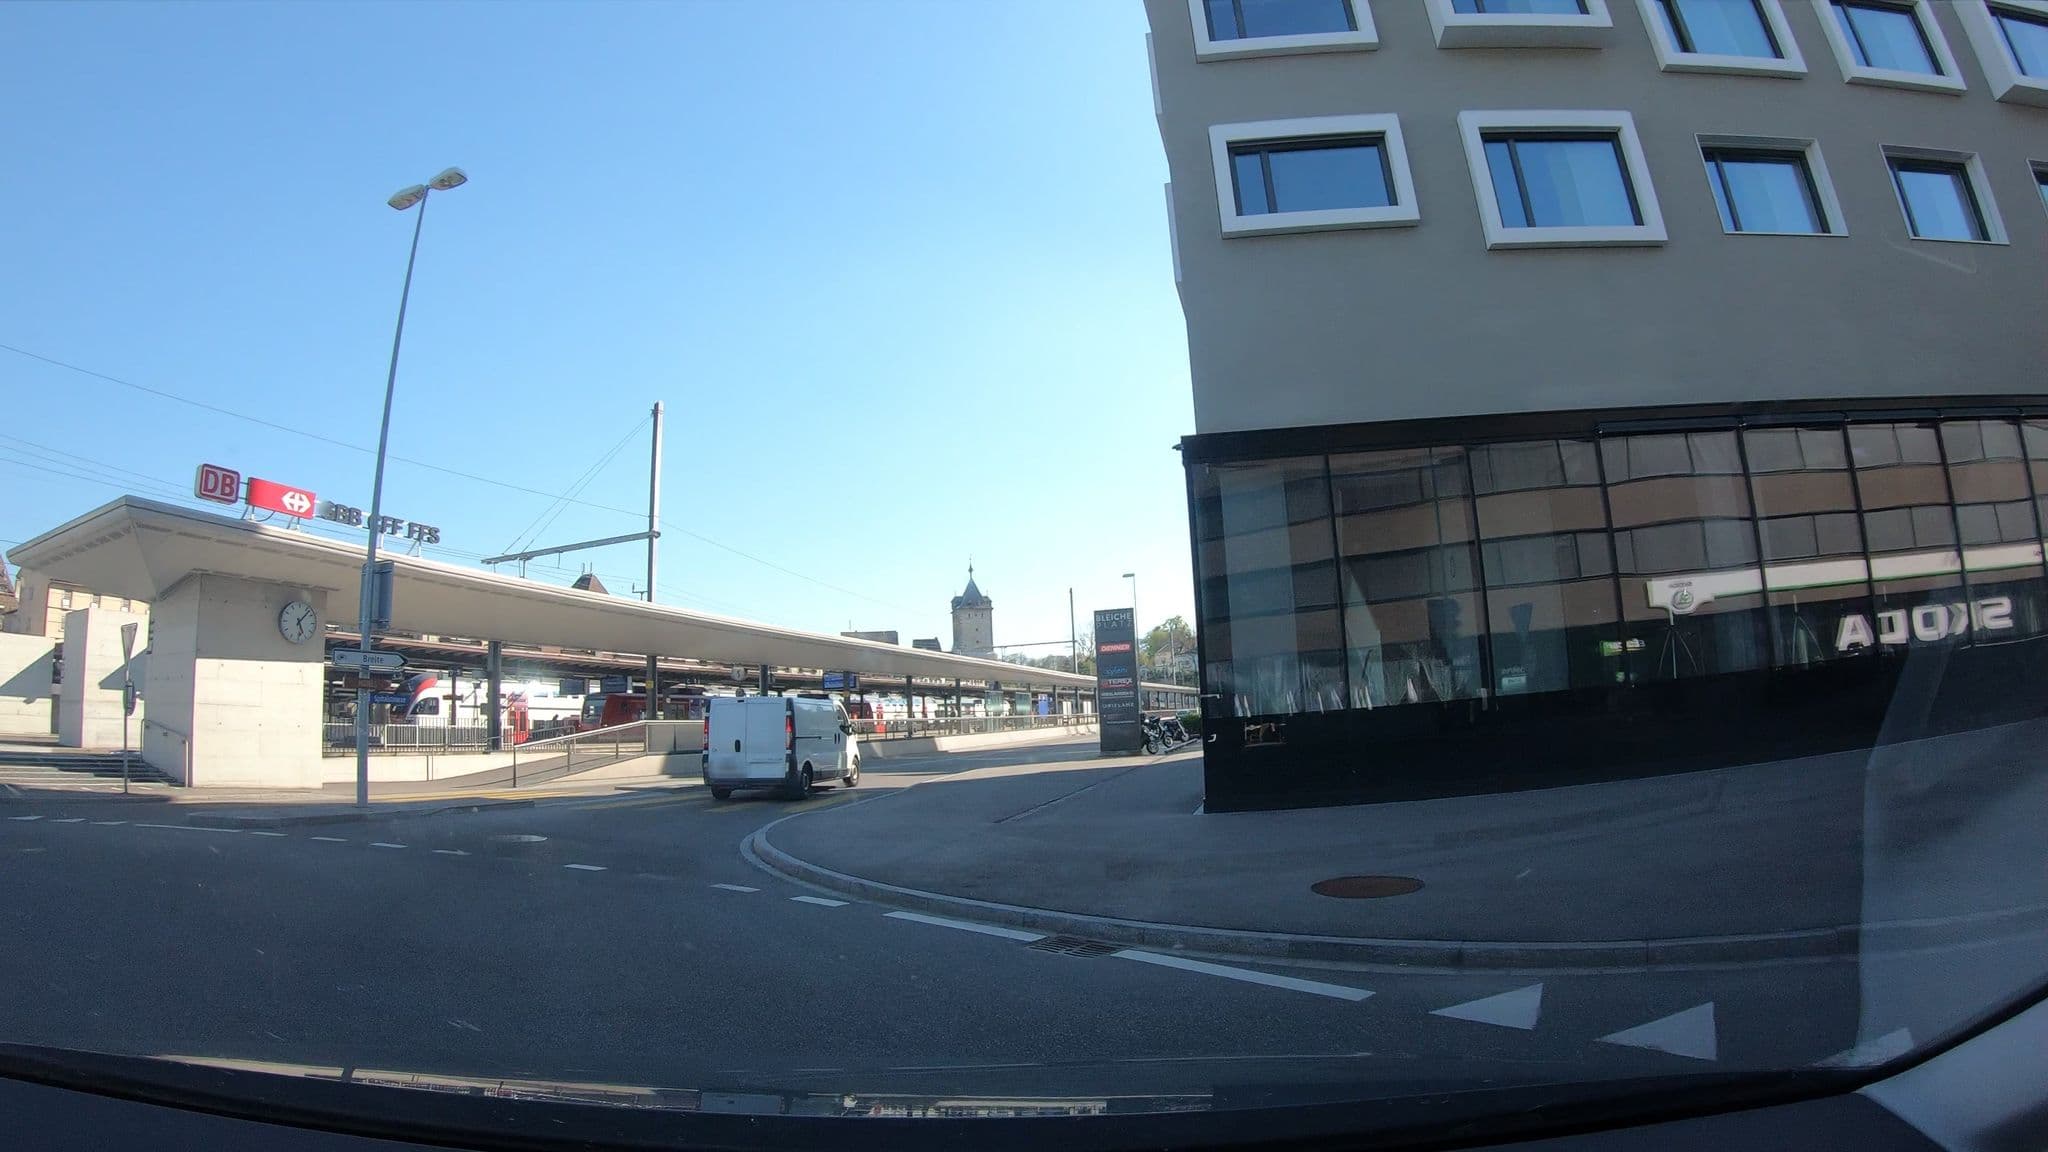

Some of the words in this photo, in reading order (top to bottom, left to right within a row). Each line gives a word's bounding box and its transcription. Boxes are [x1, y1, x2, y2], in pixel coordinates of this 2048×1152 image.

[202, 469, 236, 497] DB
[406, 521, 441, 544] FFS
[1095, 612, 1133, 622] BLEICHE
[1095, 620, 1133, 630] PLATZ
[1100, 644, 1130, 652] DENNER
[362, 654, 385, 664] Breite
